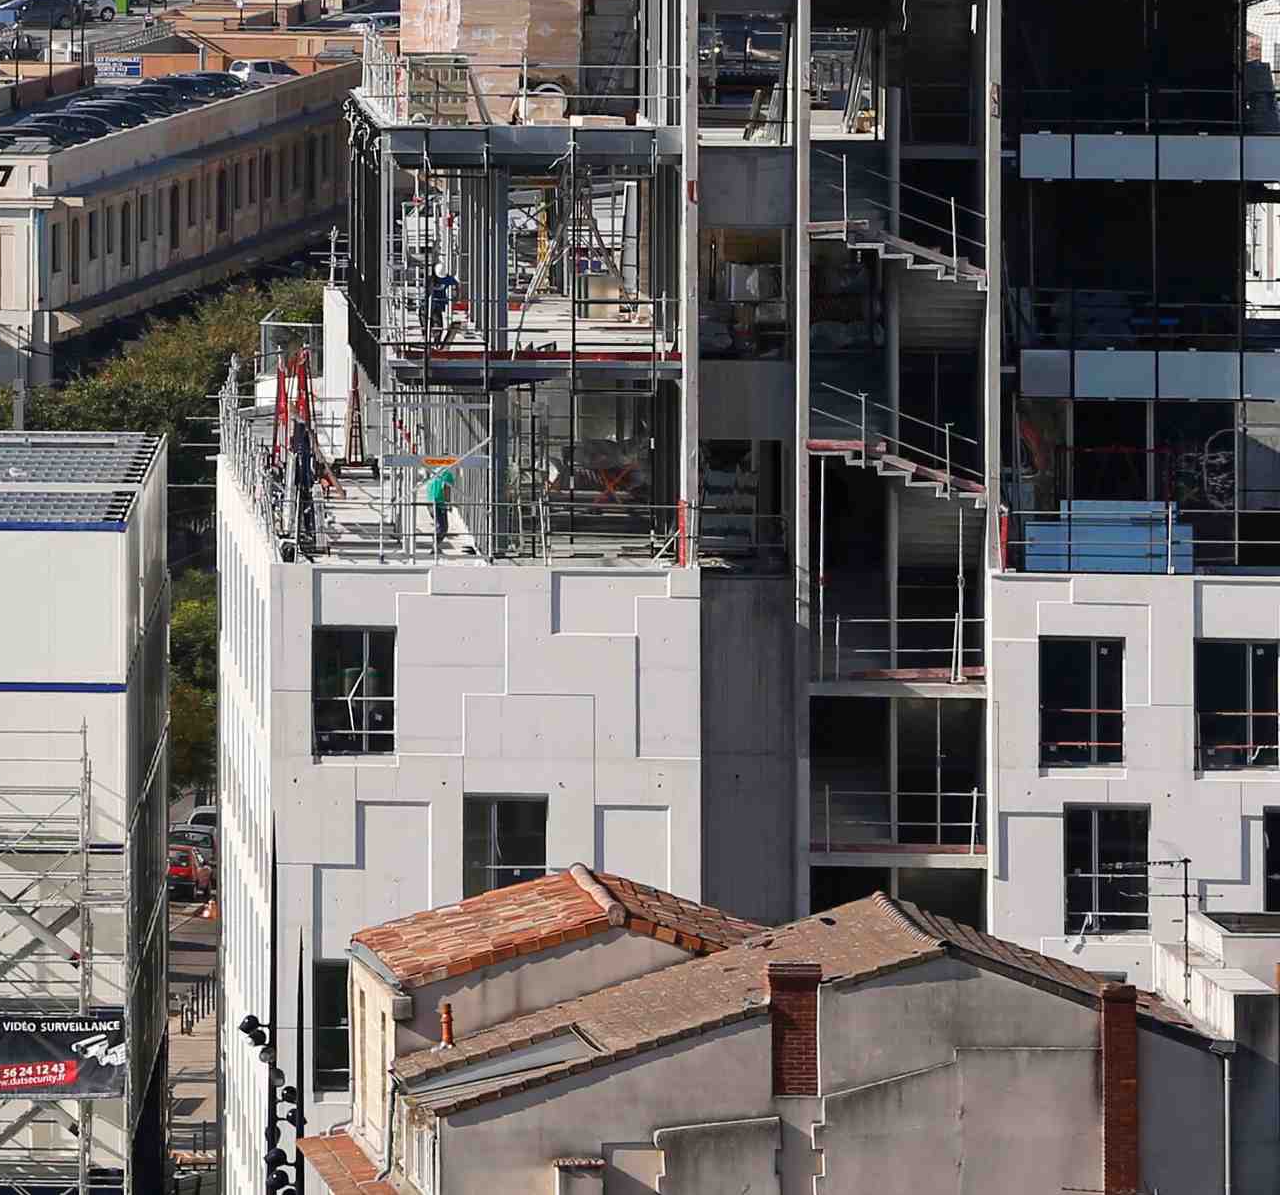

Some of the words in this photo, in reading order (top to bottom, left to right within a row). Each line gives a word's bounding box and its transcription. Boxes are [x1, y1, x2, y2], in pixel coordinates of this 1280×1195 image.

[40, 1020, 120, 1032] SURVEILLANCE
[3, 1068, 17, 1079] 56
[19, 1066, 34, 1077] 24
[36, 1065, 50, 1076] 12
[51, 1063, 66, 1074] 43
